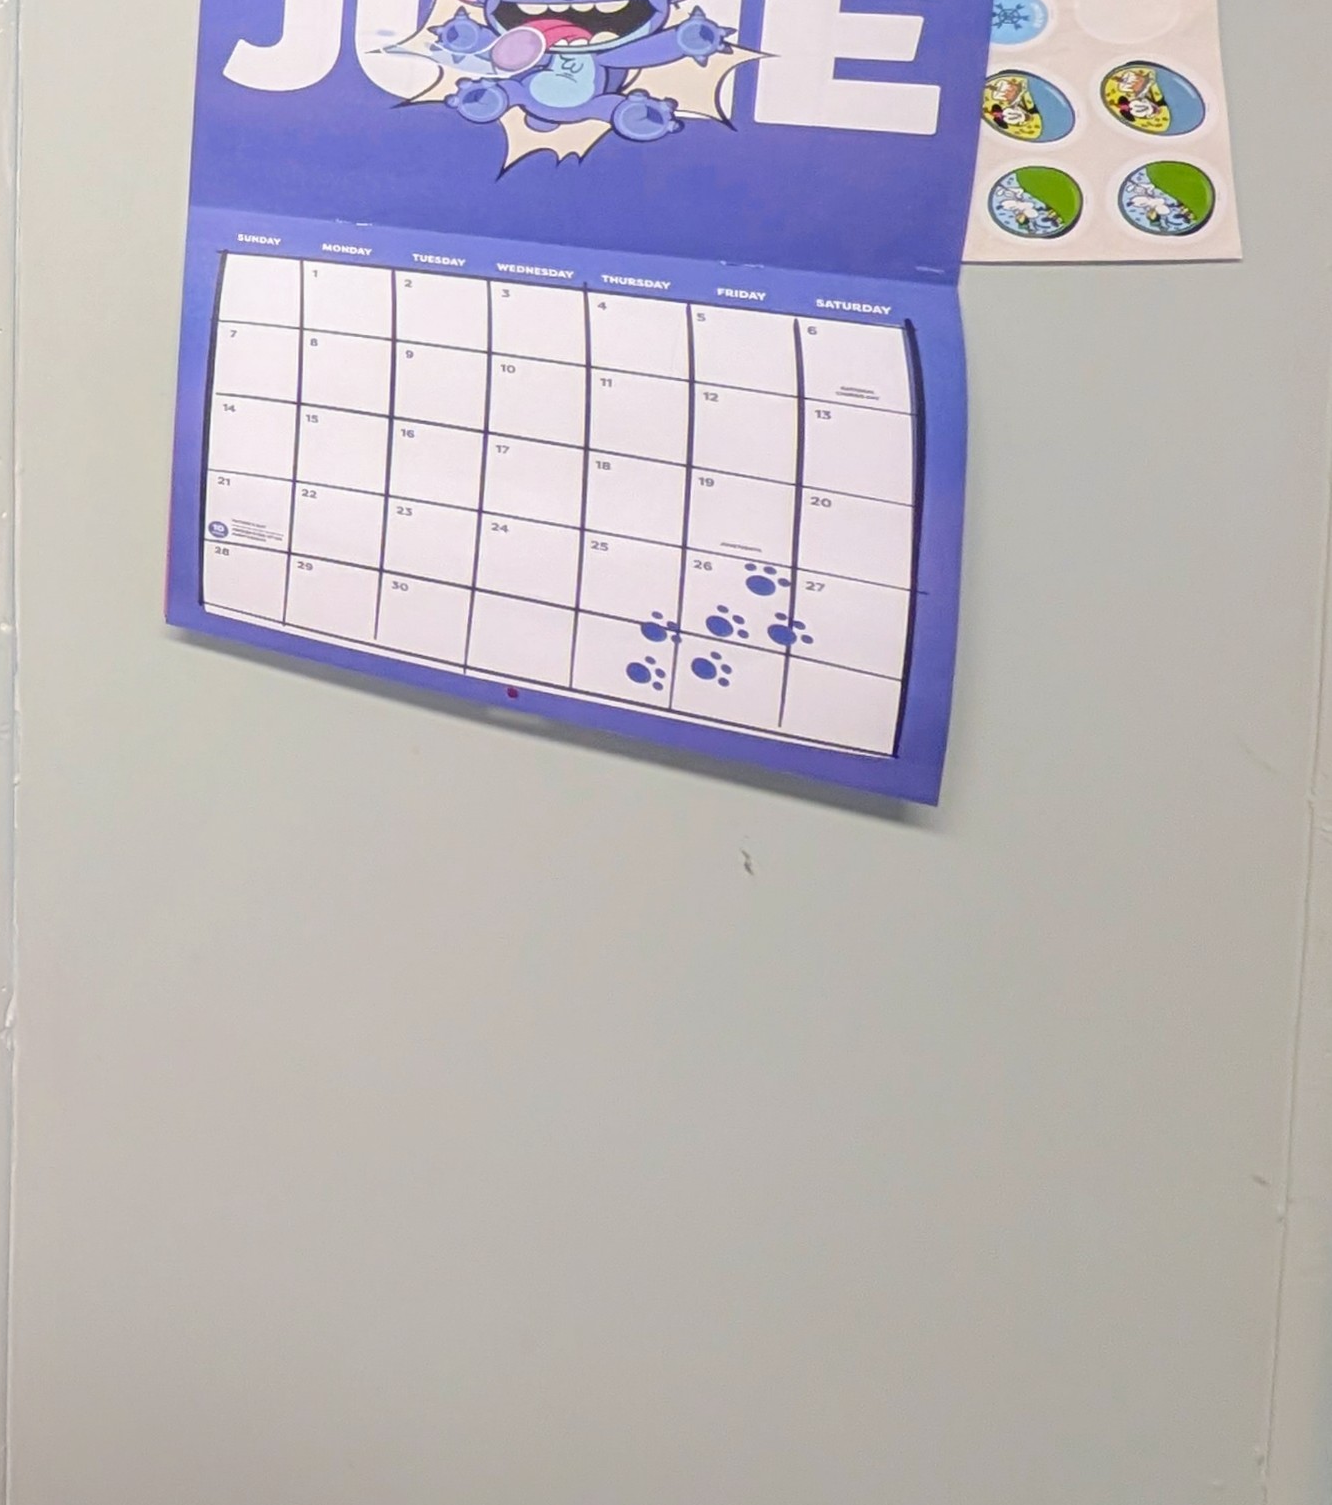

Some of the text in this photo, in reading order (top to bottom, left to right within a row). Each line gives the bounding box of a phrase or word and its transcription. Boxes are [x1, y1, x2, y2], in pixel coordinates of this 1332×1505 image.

[237, 233, 892, 316] SUNDAY MONDAY TUESDAY WEDNESDAY THURSDAY FRIDAY SATURDAY
[500, 364, 832, 420] 10 12 13
[223, 403, 832, 509] 14 15 16 17 18 19 20
[215, 546, 409, 592] 28 29 30
[217, 477, 826, 593] 21 22 23 24 25 26 27
